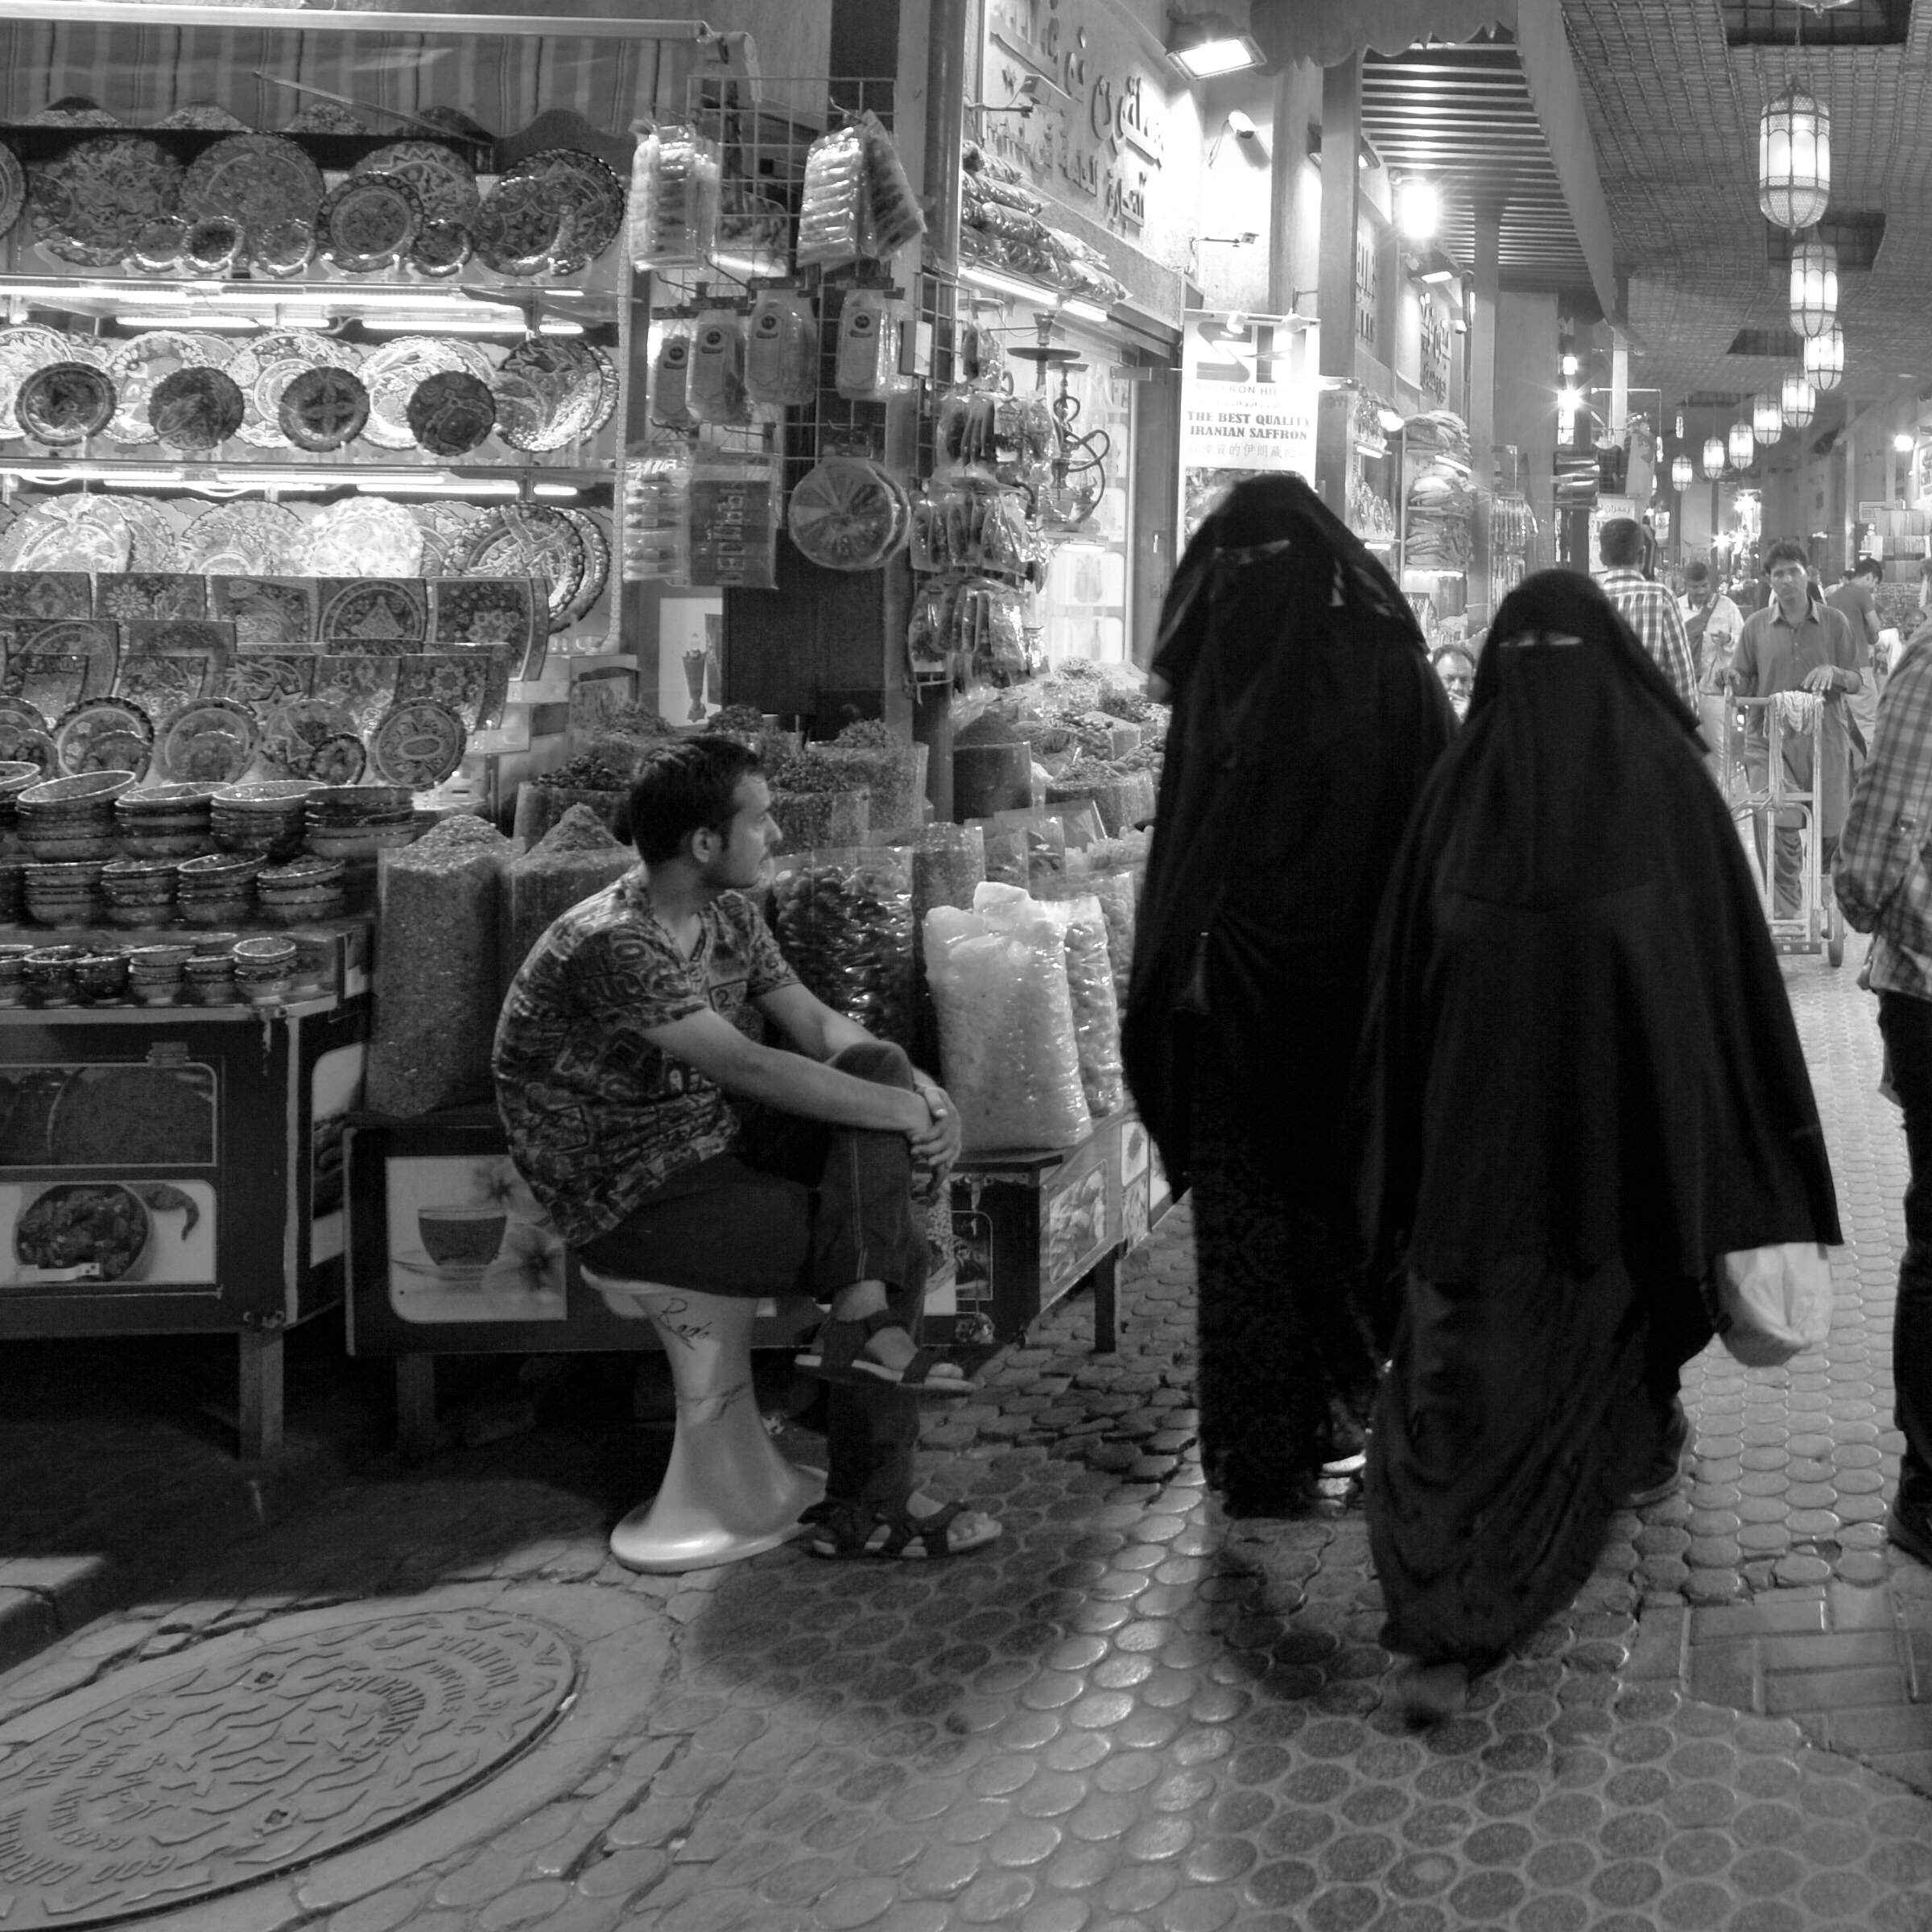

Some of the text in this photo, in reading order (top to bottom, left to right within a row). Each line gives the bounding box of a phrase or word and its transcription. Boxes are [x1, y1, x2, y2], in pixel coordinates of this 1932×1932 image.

[1187, 411, 1310, 427] THE BEST QUALITY
[1190, 425, 1307, 440] IRANIAN SAFFRON
[86, 1855, 178, 1885] 600
